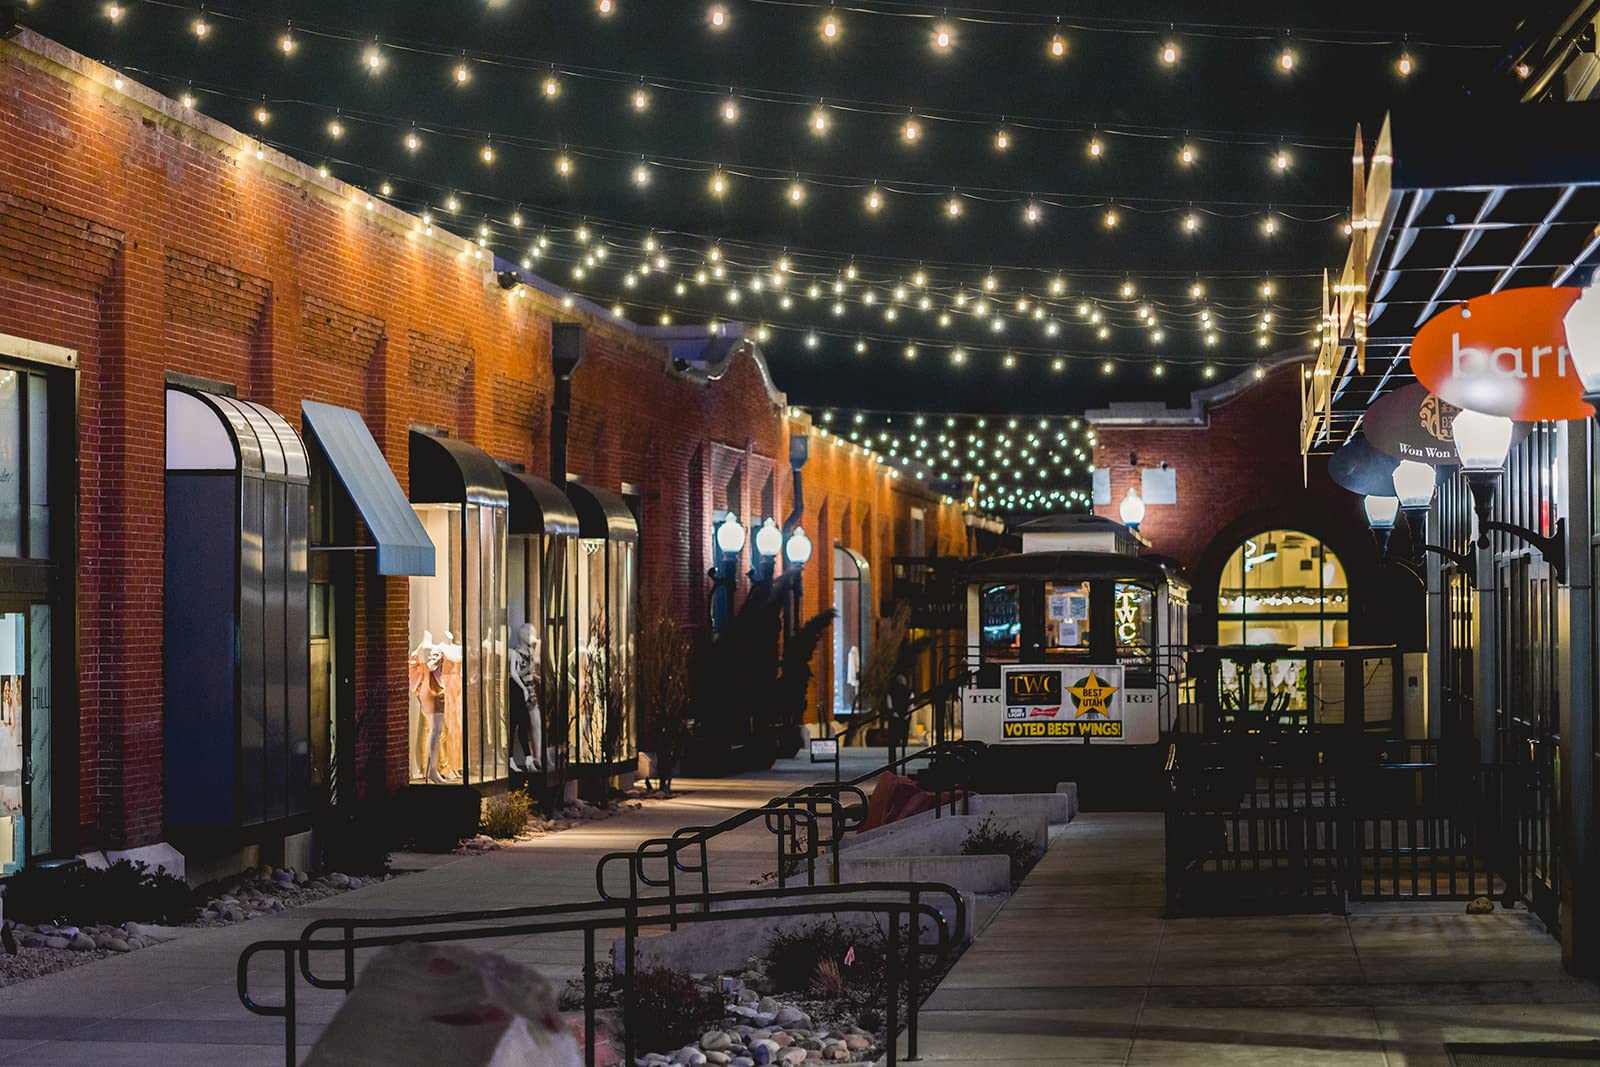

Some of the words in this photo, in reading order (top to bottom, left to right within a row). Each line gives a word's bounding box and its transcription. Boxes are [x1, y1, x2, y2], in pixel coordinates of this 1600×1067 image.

[1399, 442, 1424, 457] Won
[1425, 447, 1451, 458] Won
[1008, 674, 1057, 695] TWC
[1083, 688, 1103, 697] BEST
[1083, 699, 1103, 707] UTAH
[1005, 722, 1046, 736] VOTED
[1048, 722, 1076, 736] BEST
[1079, 722, 1121, 736] WINGS!
